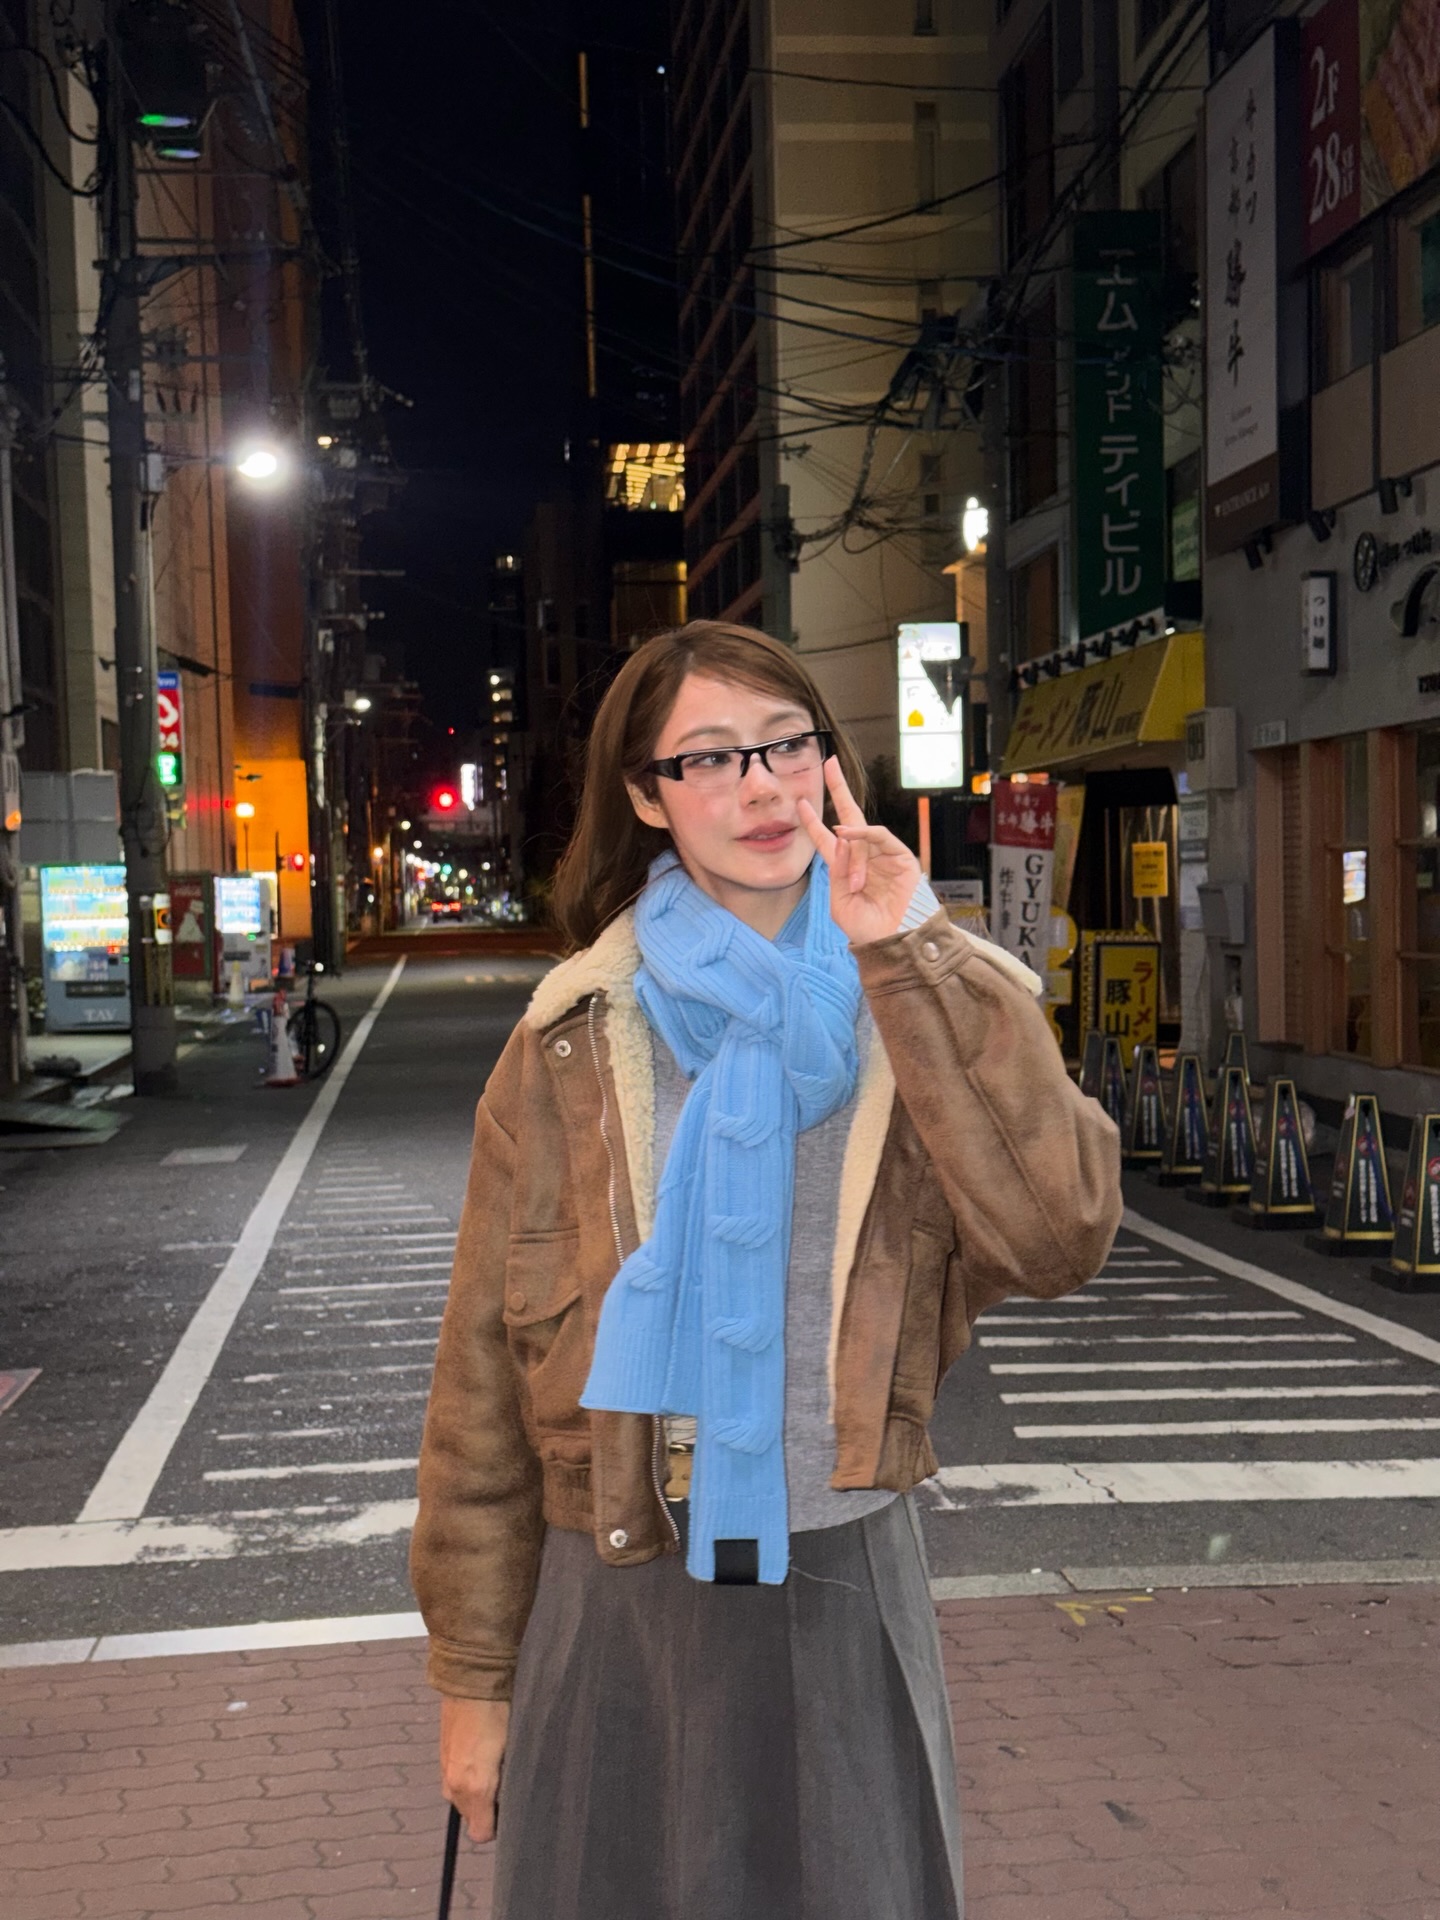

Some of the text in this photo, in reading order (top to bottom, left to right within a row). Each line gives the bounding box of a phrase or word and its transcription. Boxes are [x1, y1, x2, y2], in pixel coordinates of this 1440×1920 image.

[1310, 45, 1340, 130] 2F
[1105, 979, 1131, 1036] 豚山
[1133, 961, 1153, 1045] ラーメン
